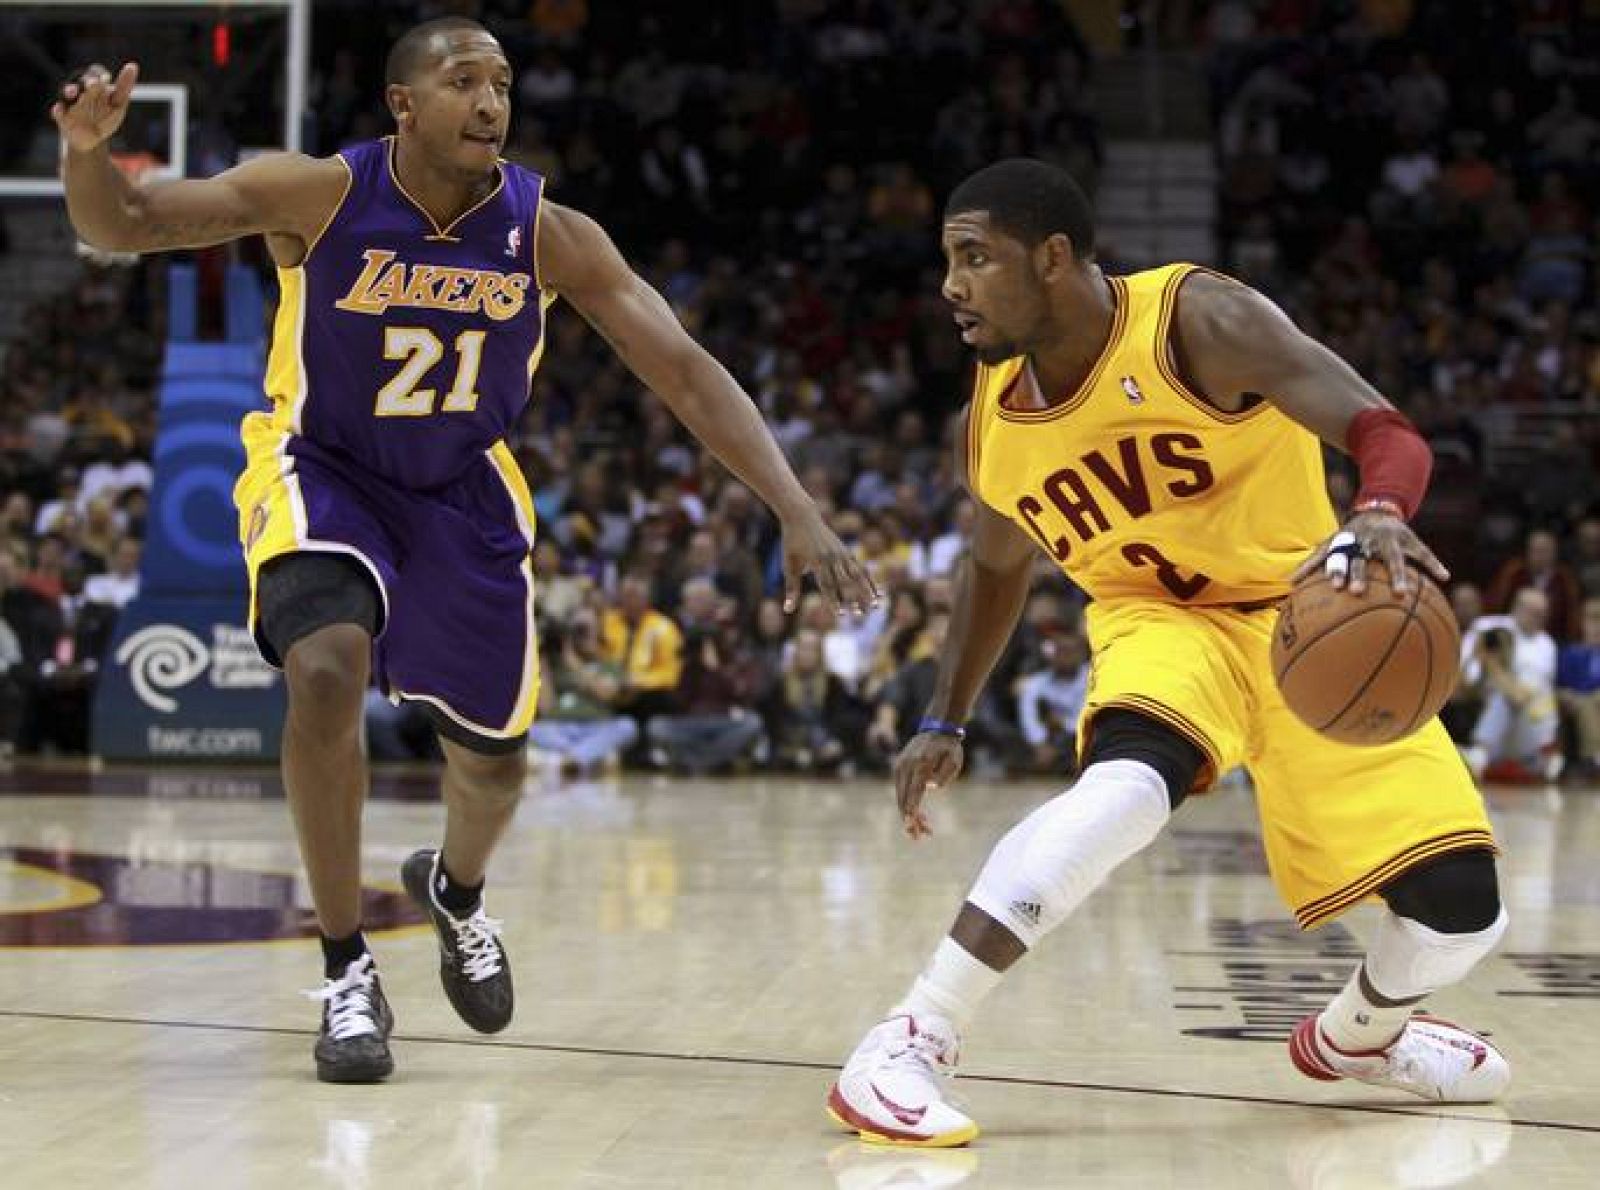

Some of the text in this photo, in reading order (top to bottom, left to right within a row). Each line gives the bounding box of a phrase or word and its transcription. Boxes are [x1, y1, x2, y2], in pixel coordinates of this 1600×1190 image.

[335, 248, 533, 322] LAKERS
[373, 326, 487, 417] 21
[1016, 432, 1215, 563] CAVS
[1121, 543, 1212, 602] 2
